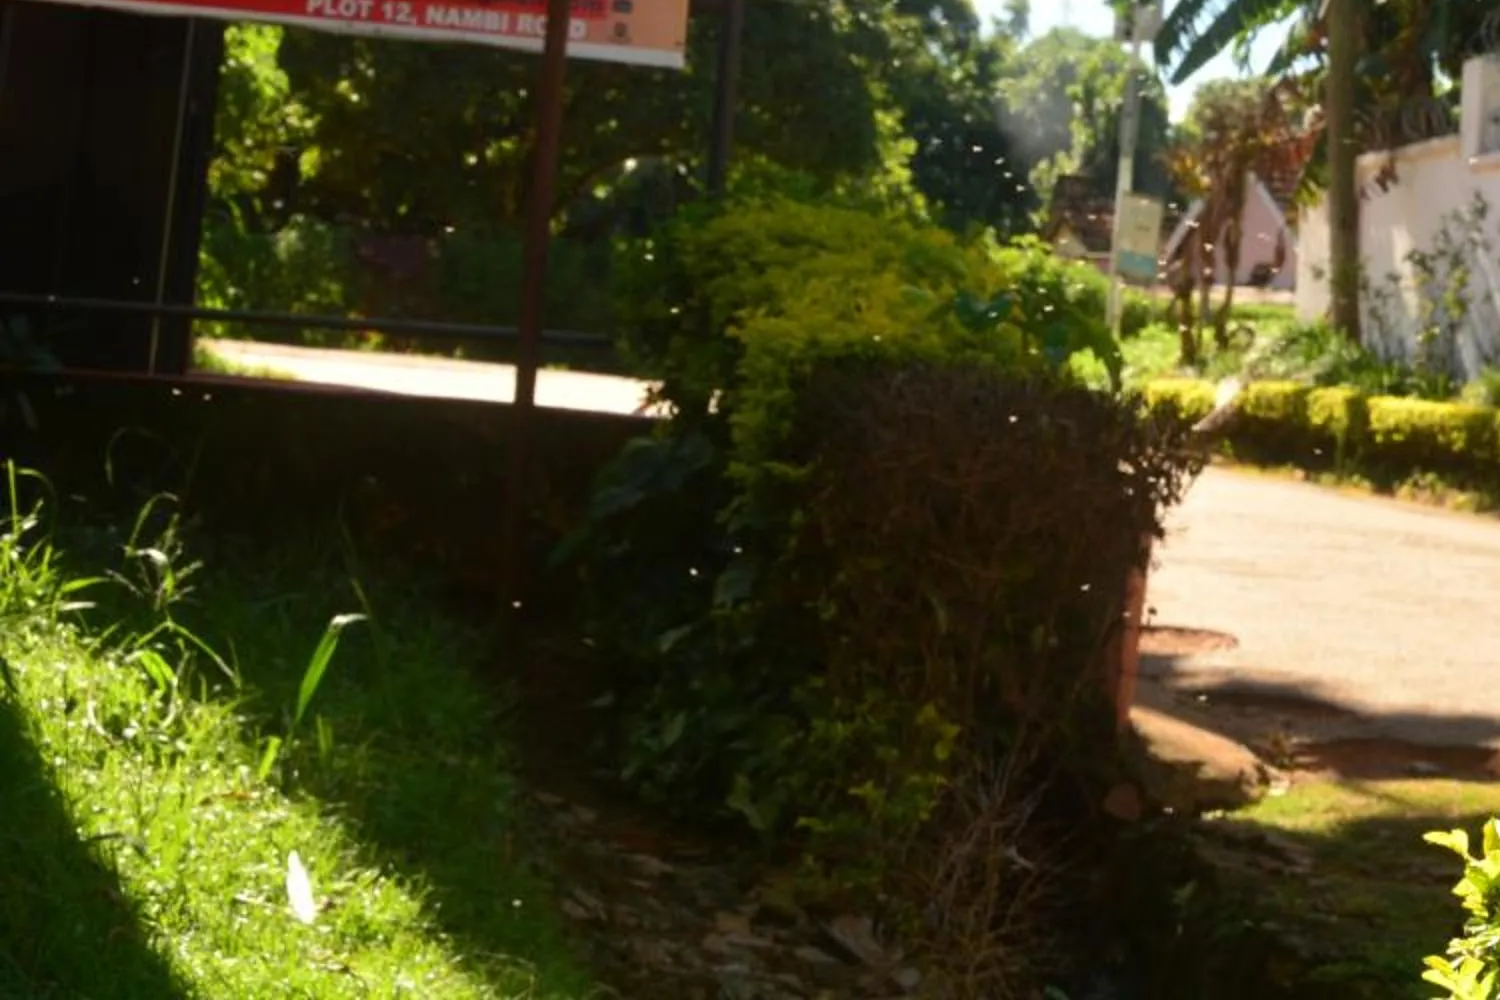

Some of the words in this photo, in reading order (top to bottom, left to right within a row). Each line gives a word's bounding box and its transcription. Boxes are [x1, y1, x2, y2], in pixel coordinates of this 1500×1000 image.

[382, 0, 418, 26] 12,
[425, 3, 509, 32] NAMBI
[516, 11, 588, 41] ROD
